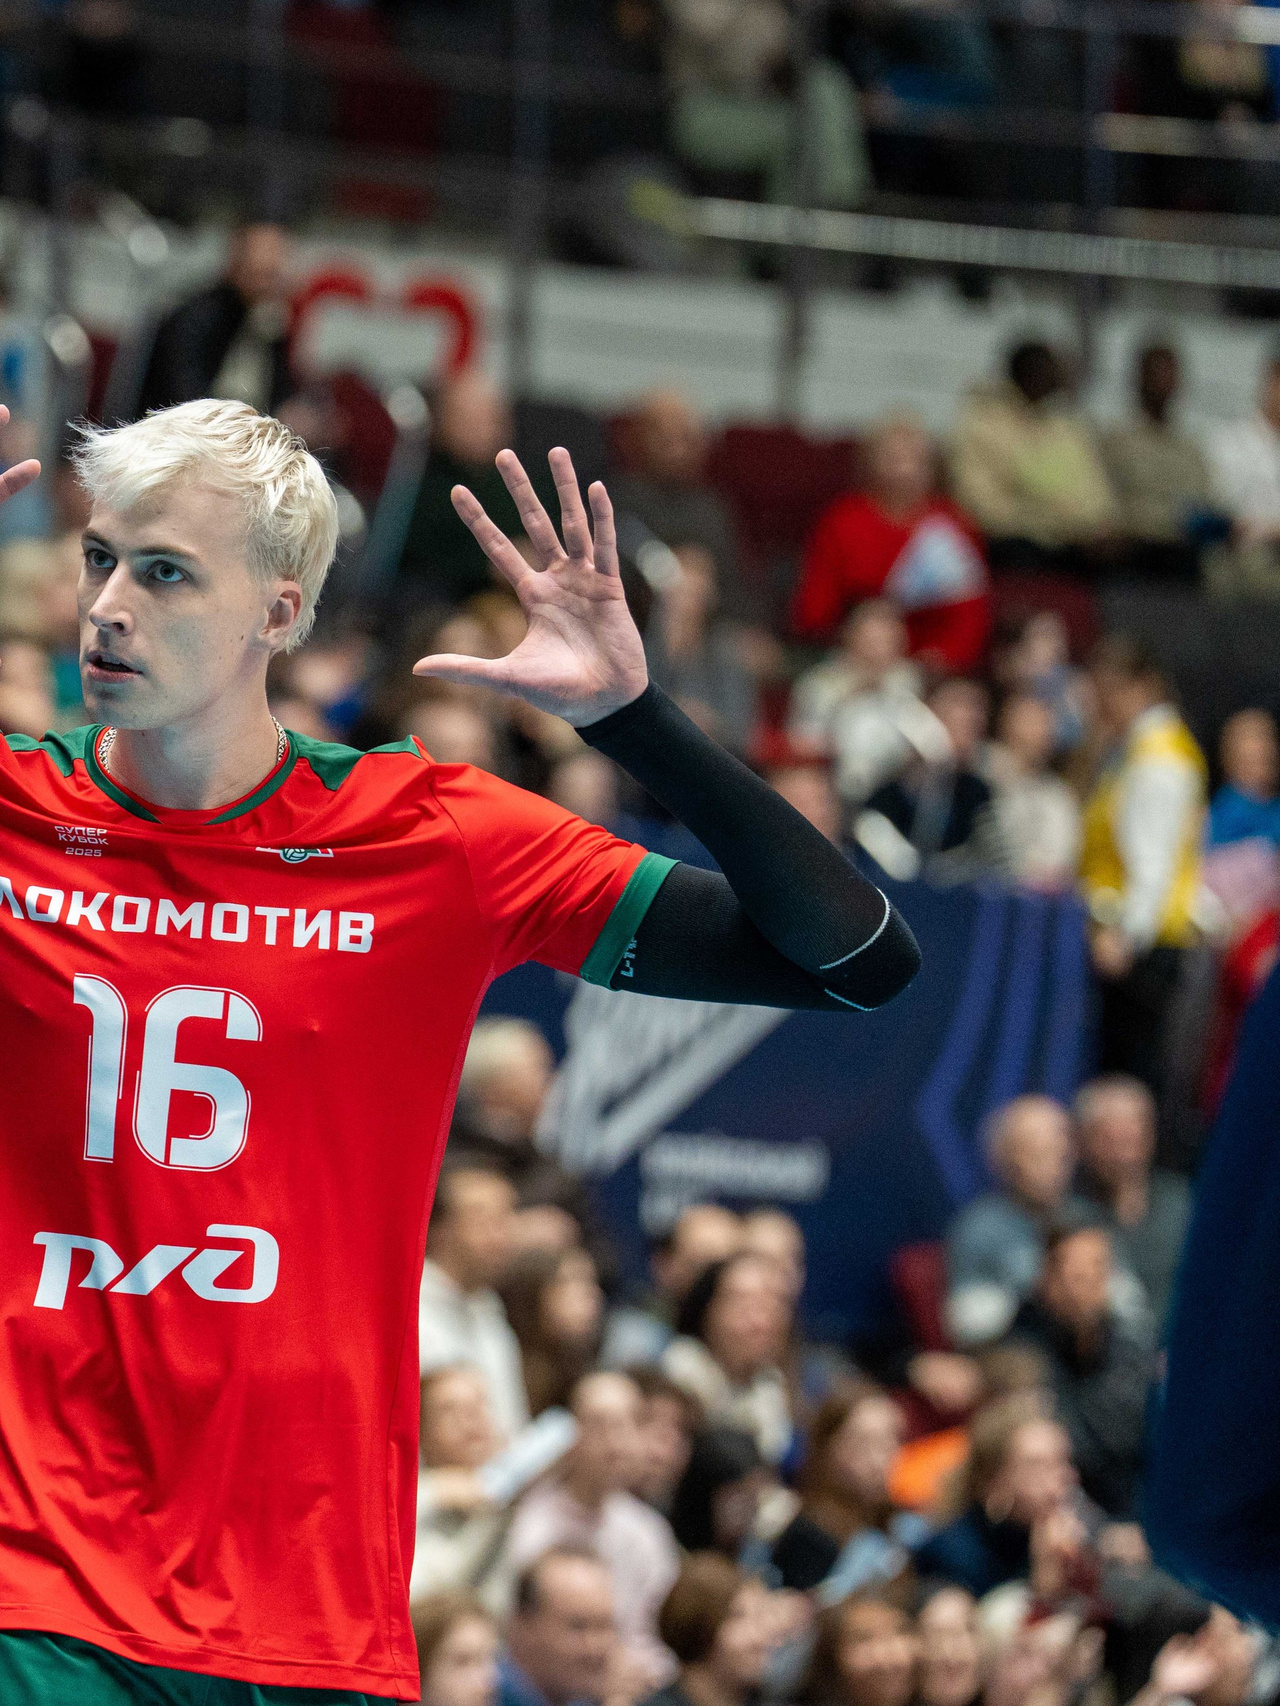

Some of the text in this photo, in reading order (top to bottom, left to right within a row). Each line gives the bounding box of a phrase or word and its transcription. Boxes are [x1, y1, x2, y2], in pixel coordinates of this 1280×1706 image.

[54, 825, 107, 836] СУПЕР
[58, 833, 109, 845] КУБОК
[65, 847, 102, 857] 2025
[73, 972, 263, 1172] 16
